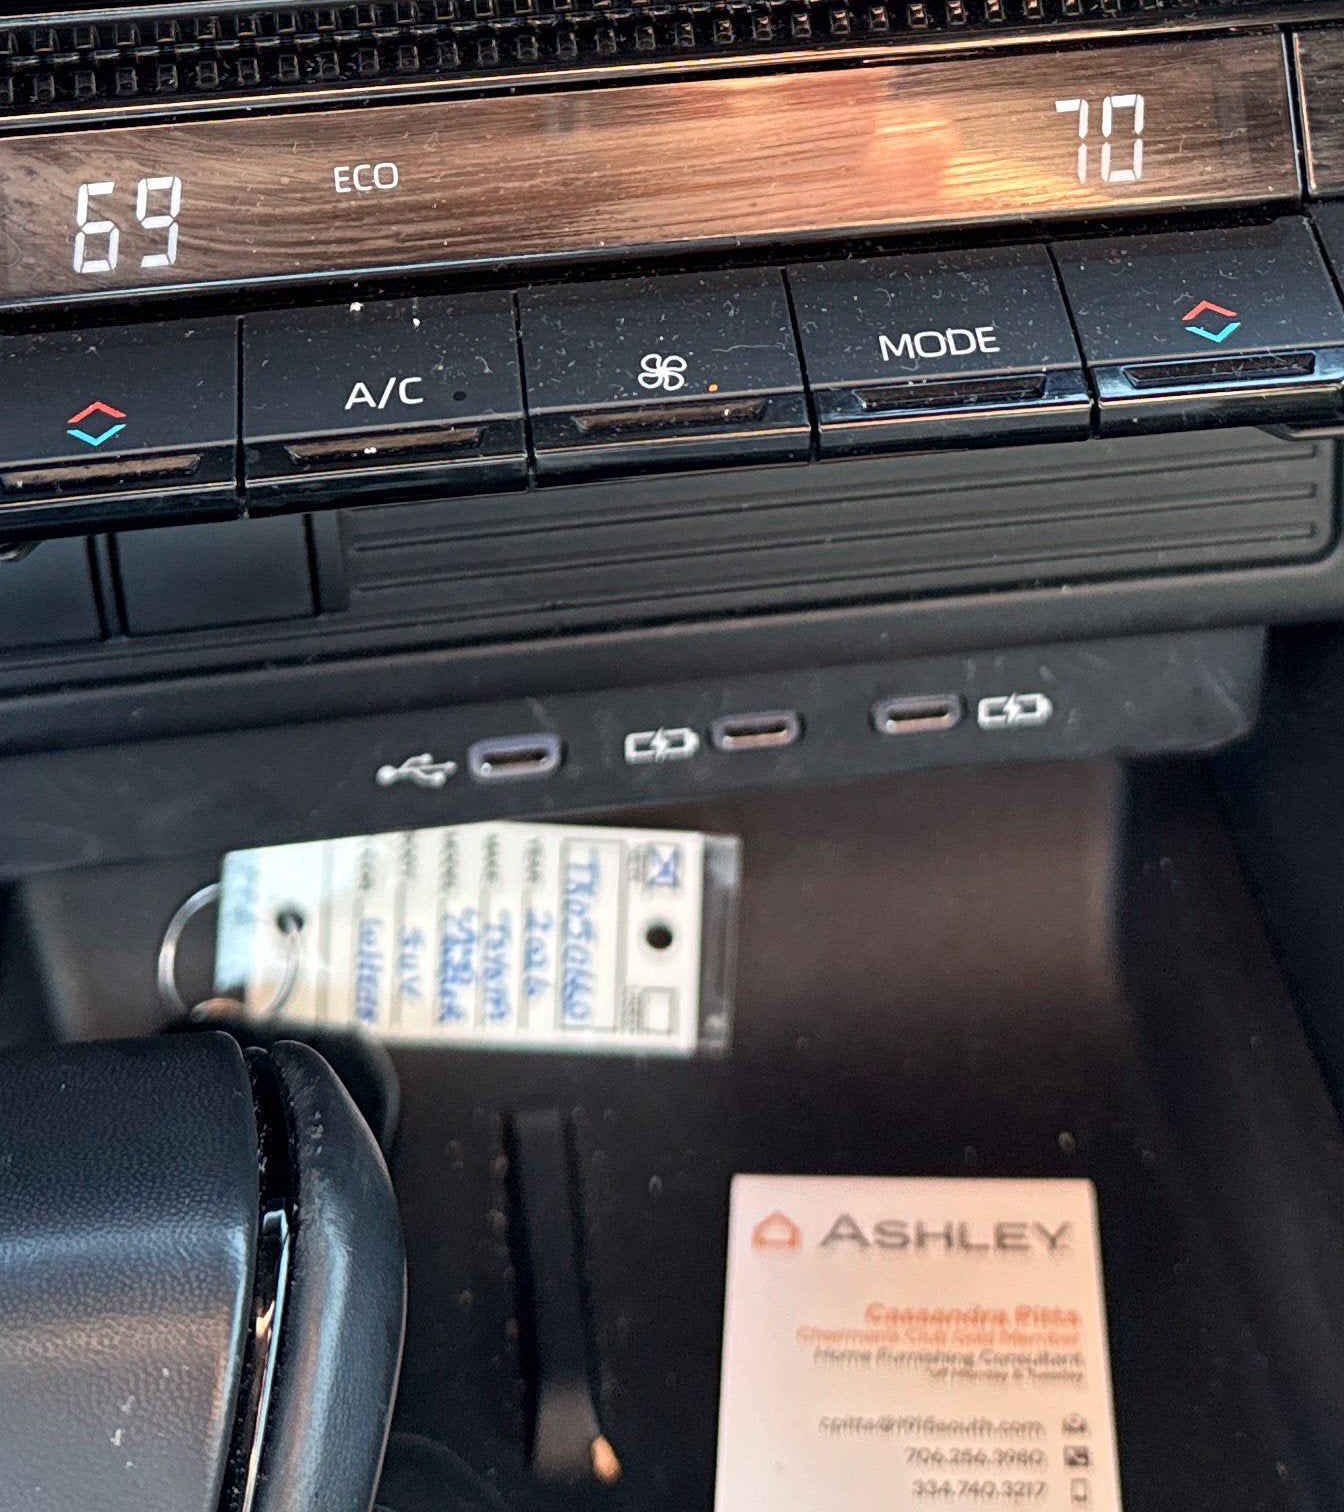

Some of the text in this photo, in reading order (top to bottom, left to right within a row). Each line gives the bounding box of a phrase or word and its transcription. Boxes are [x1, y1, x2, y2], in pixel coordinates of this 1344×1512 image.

[1056, 93, 1145, 184] 70
[333, 162, 400, 194] ECO
[72, 174, 182, 273] 69
[878, 325, 1002, 361] MODE
[344, 374, 425, 410] A/C
[819, 1213, 1071, 1252] ASHLEY
